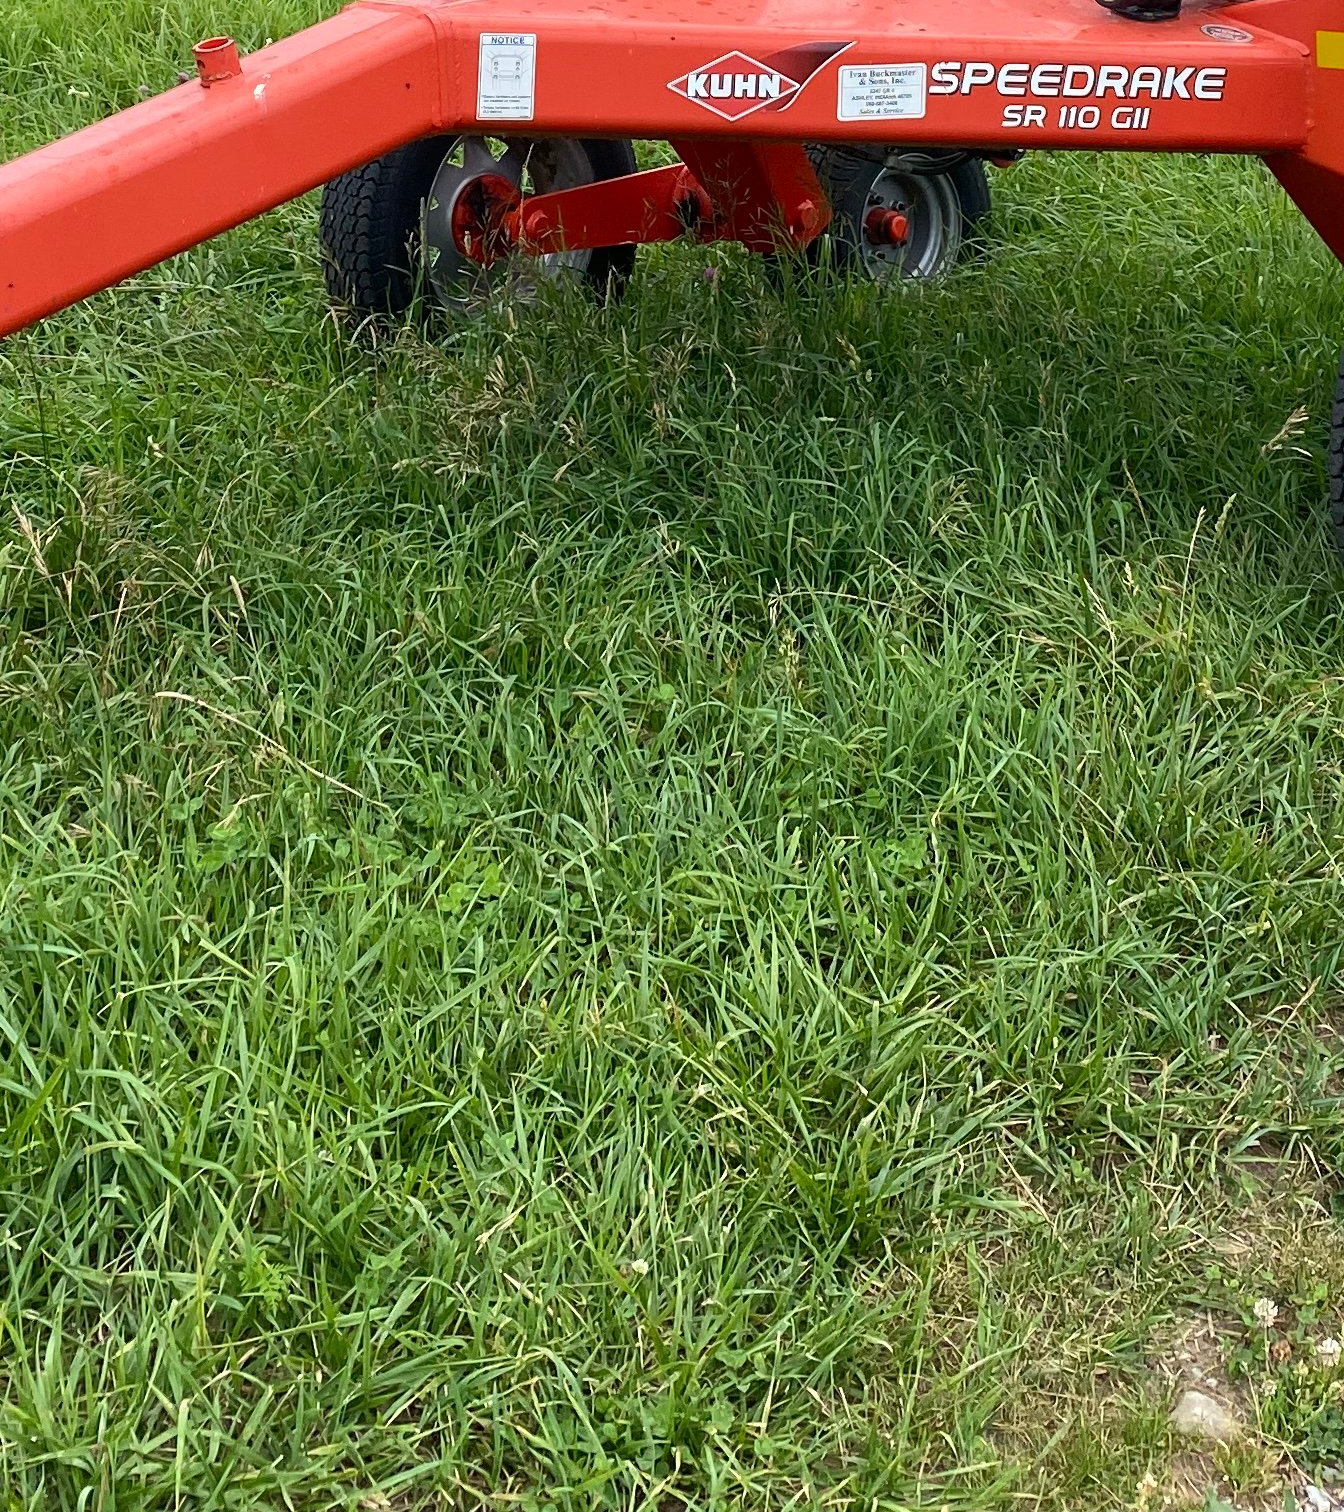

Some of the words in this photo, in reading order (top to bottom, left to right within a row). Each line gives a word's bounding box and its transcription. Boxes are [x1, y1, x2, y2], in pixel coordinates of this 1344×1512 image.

[491, 36, 525, 44] NOTICE
[849, 70, 867, 78] Ivan
[869, 69, 916, 78] Buckmaster
[929, 62, 1227, 100] SPEEDRAKE
[686, 73, 781, 99] KUHN
[1001, 105, 1047, 128] SR
[1058, 105, 1101, 129] 110
[1110, 106, 1151, 129] GII
